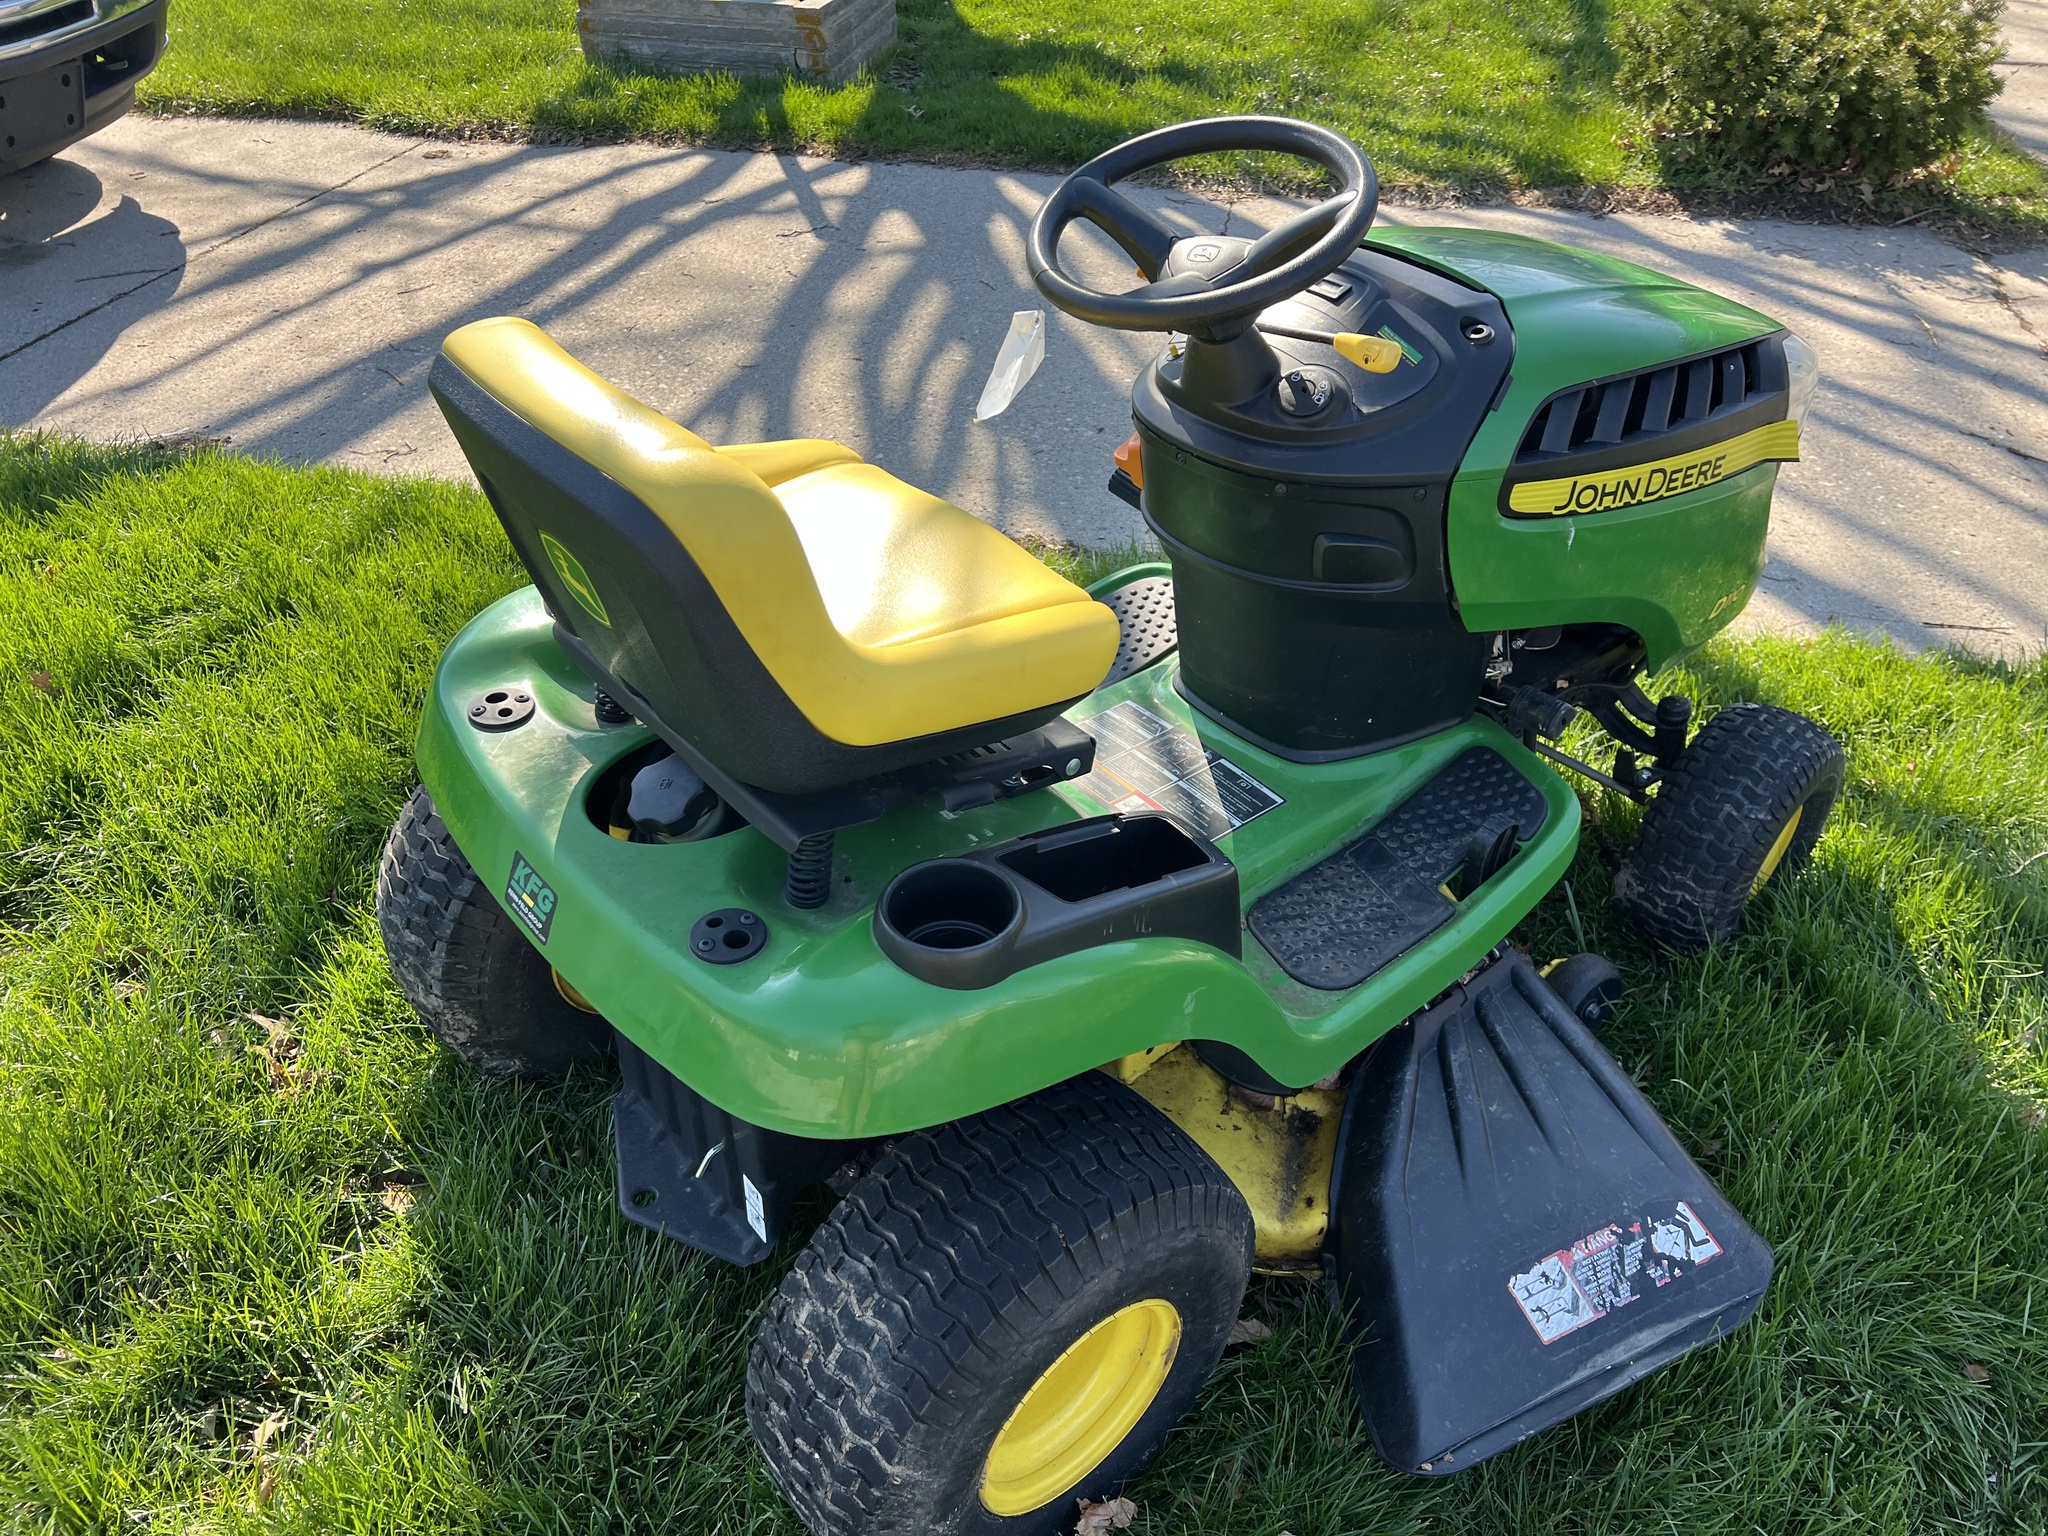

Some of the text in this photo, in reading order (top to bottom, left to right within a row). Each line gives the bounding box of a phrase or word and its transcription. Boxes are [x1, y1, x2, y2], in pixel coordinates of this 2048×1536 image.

[1554, 455, 1727, 510] JOHN DEERE
[514, 860, 555, 913] KFG
